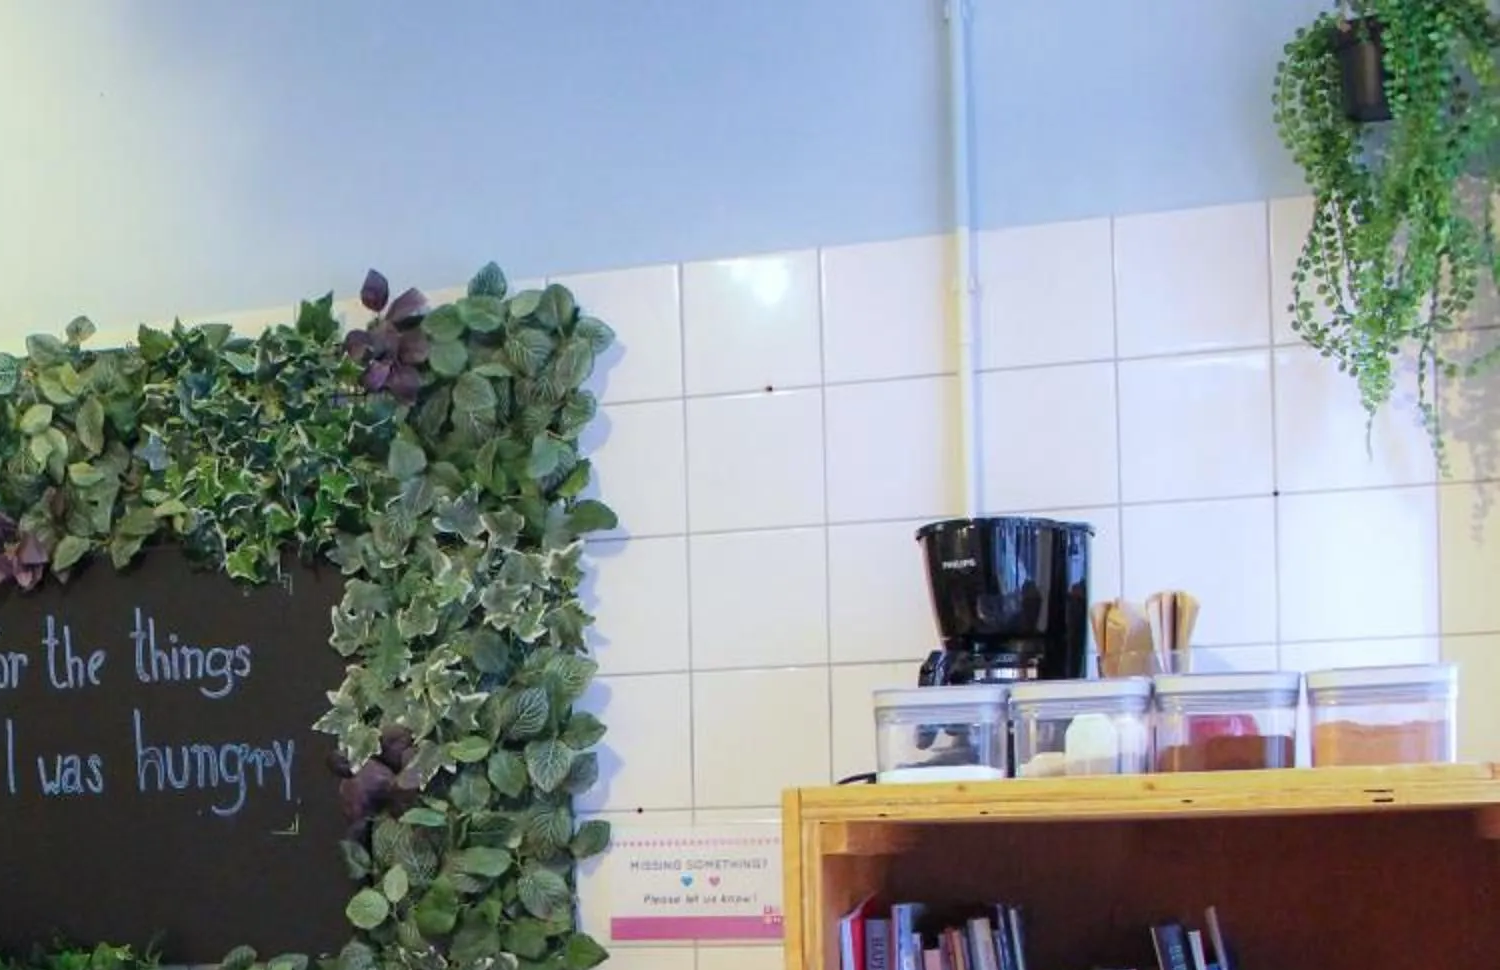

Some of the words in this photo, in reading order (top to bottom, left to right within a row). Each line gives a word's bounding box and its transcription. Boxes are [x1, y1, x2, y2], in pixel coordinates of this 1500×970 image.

[41, 614, 108, 691] the
[129, 606, 252, 700] things
[6, 717, 17, 795] I
[37, 753, 105, 796] was
[132, 707, 296, 817] hungry
[630, 859, 682, 872] MISSING
[685, 858, 769, 871] SOMETHING?
[643, 894, 681, 905] Please
[686, 895, 700, 905] let
[703, 895, 717, 905] us
